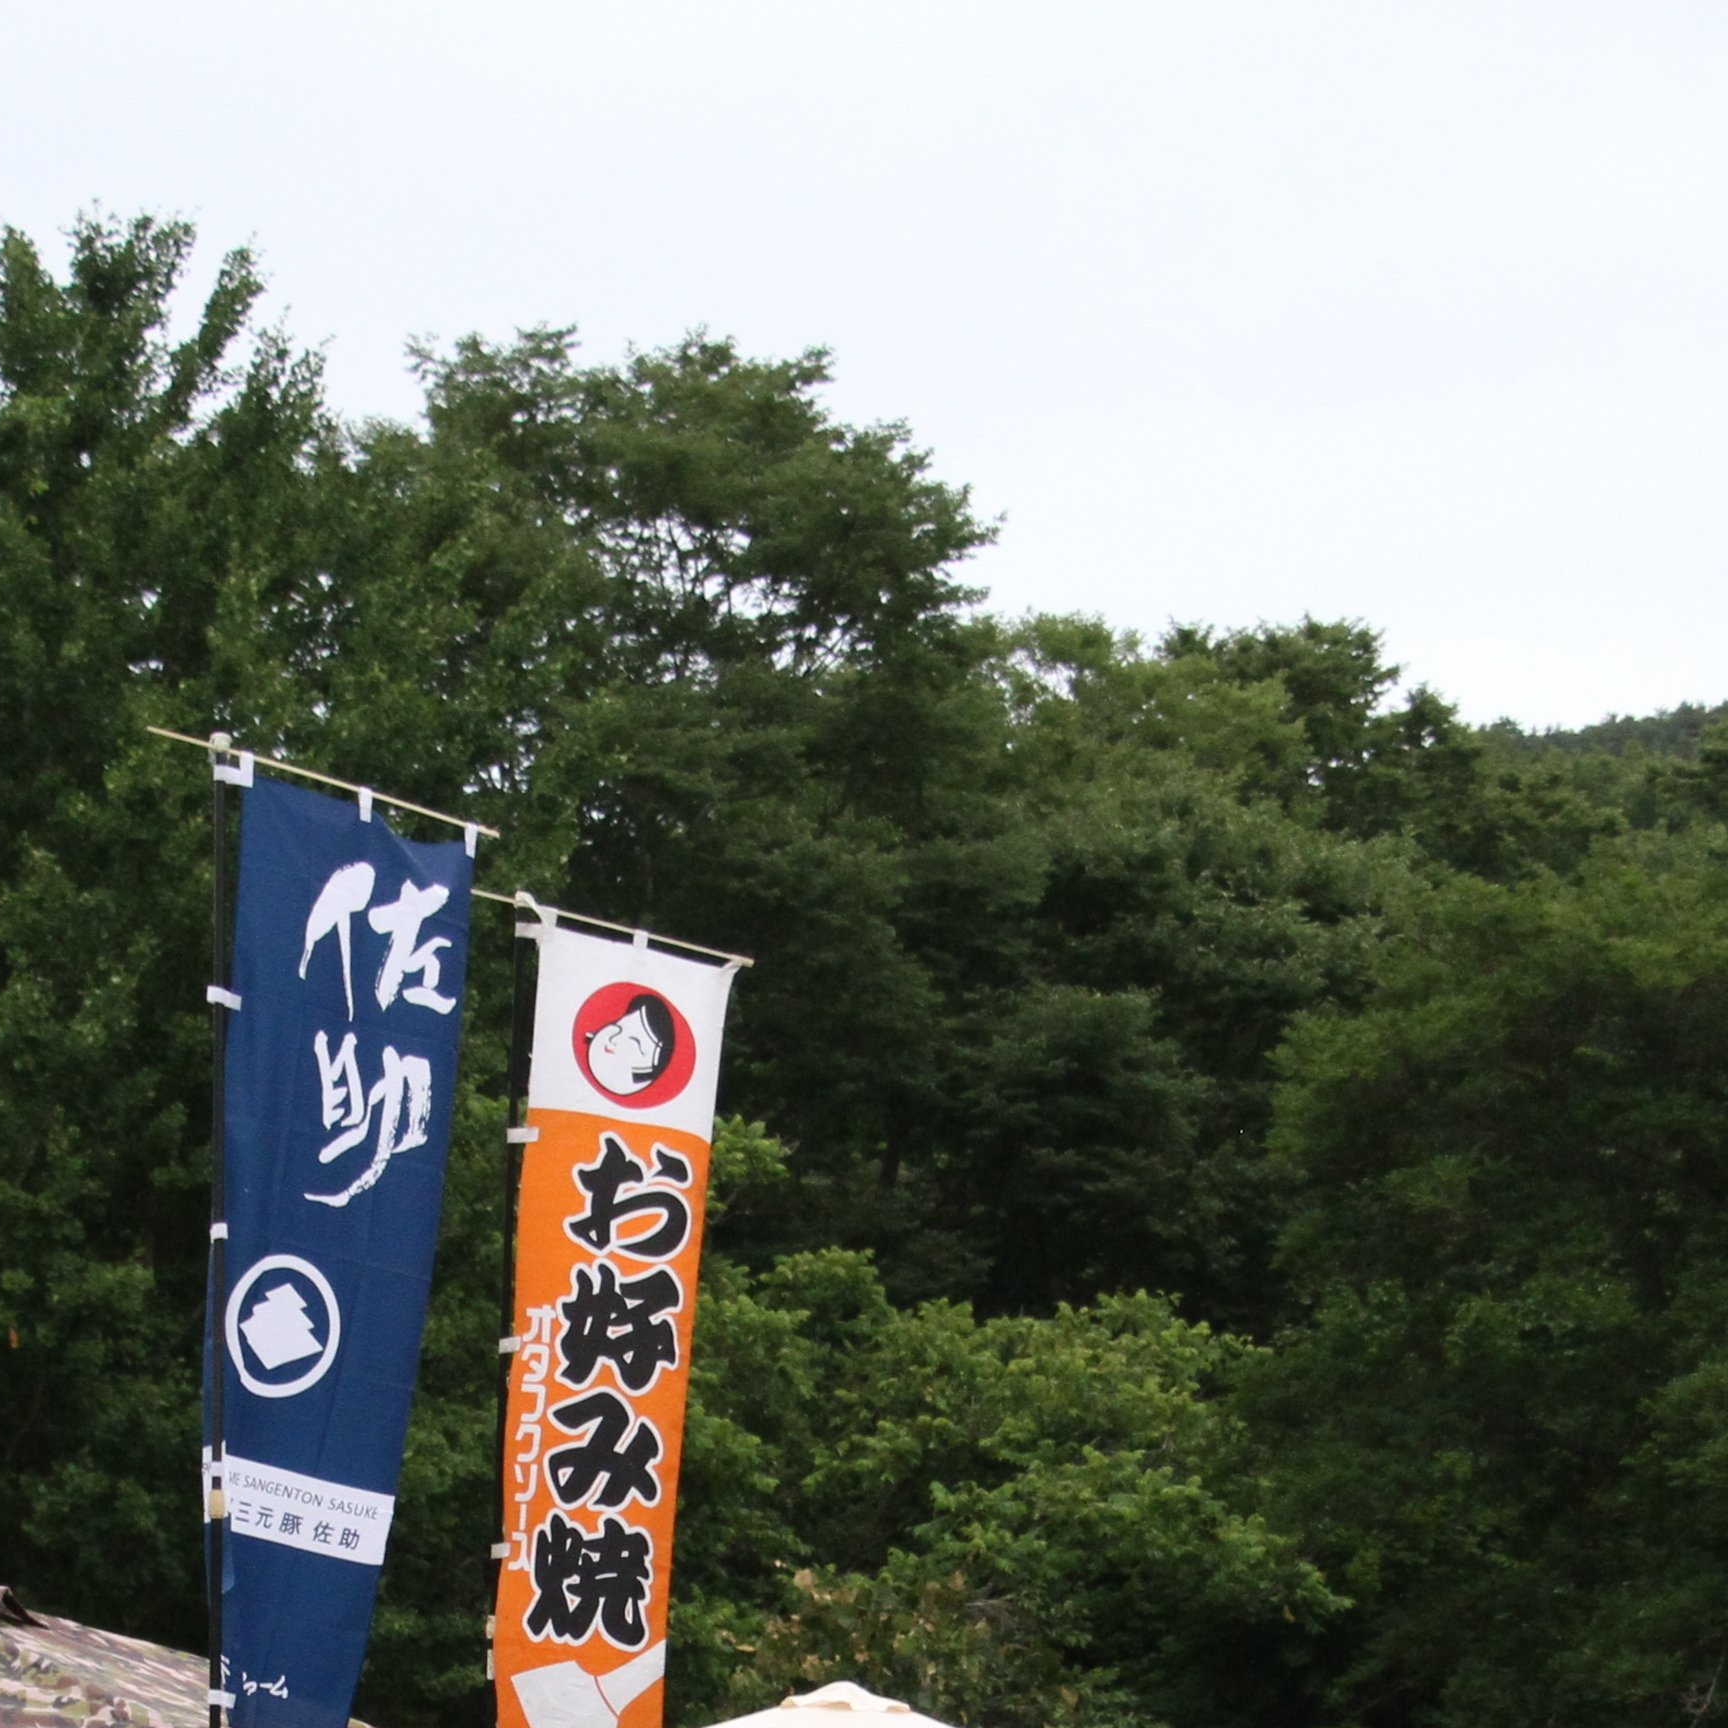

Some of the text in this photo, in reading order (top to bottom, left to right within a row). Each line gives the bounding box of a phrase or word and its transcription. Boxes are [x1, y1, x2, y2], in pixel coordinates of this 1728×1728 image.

[298, 861, 456, 1208] 佐助
[524, 1132, 693, 1650] お好み焼
[243, 1475, 324, 1508] SANGENTON
[313, 1520, 361, 1551] 佐助
